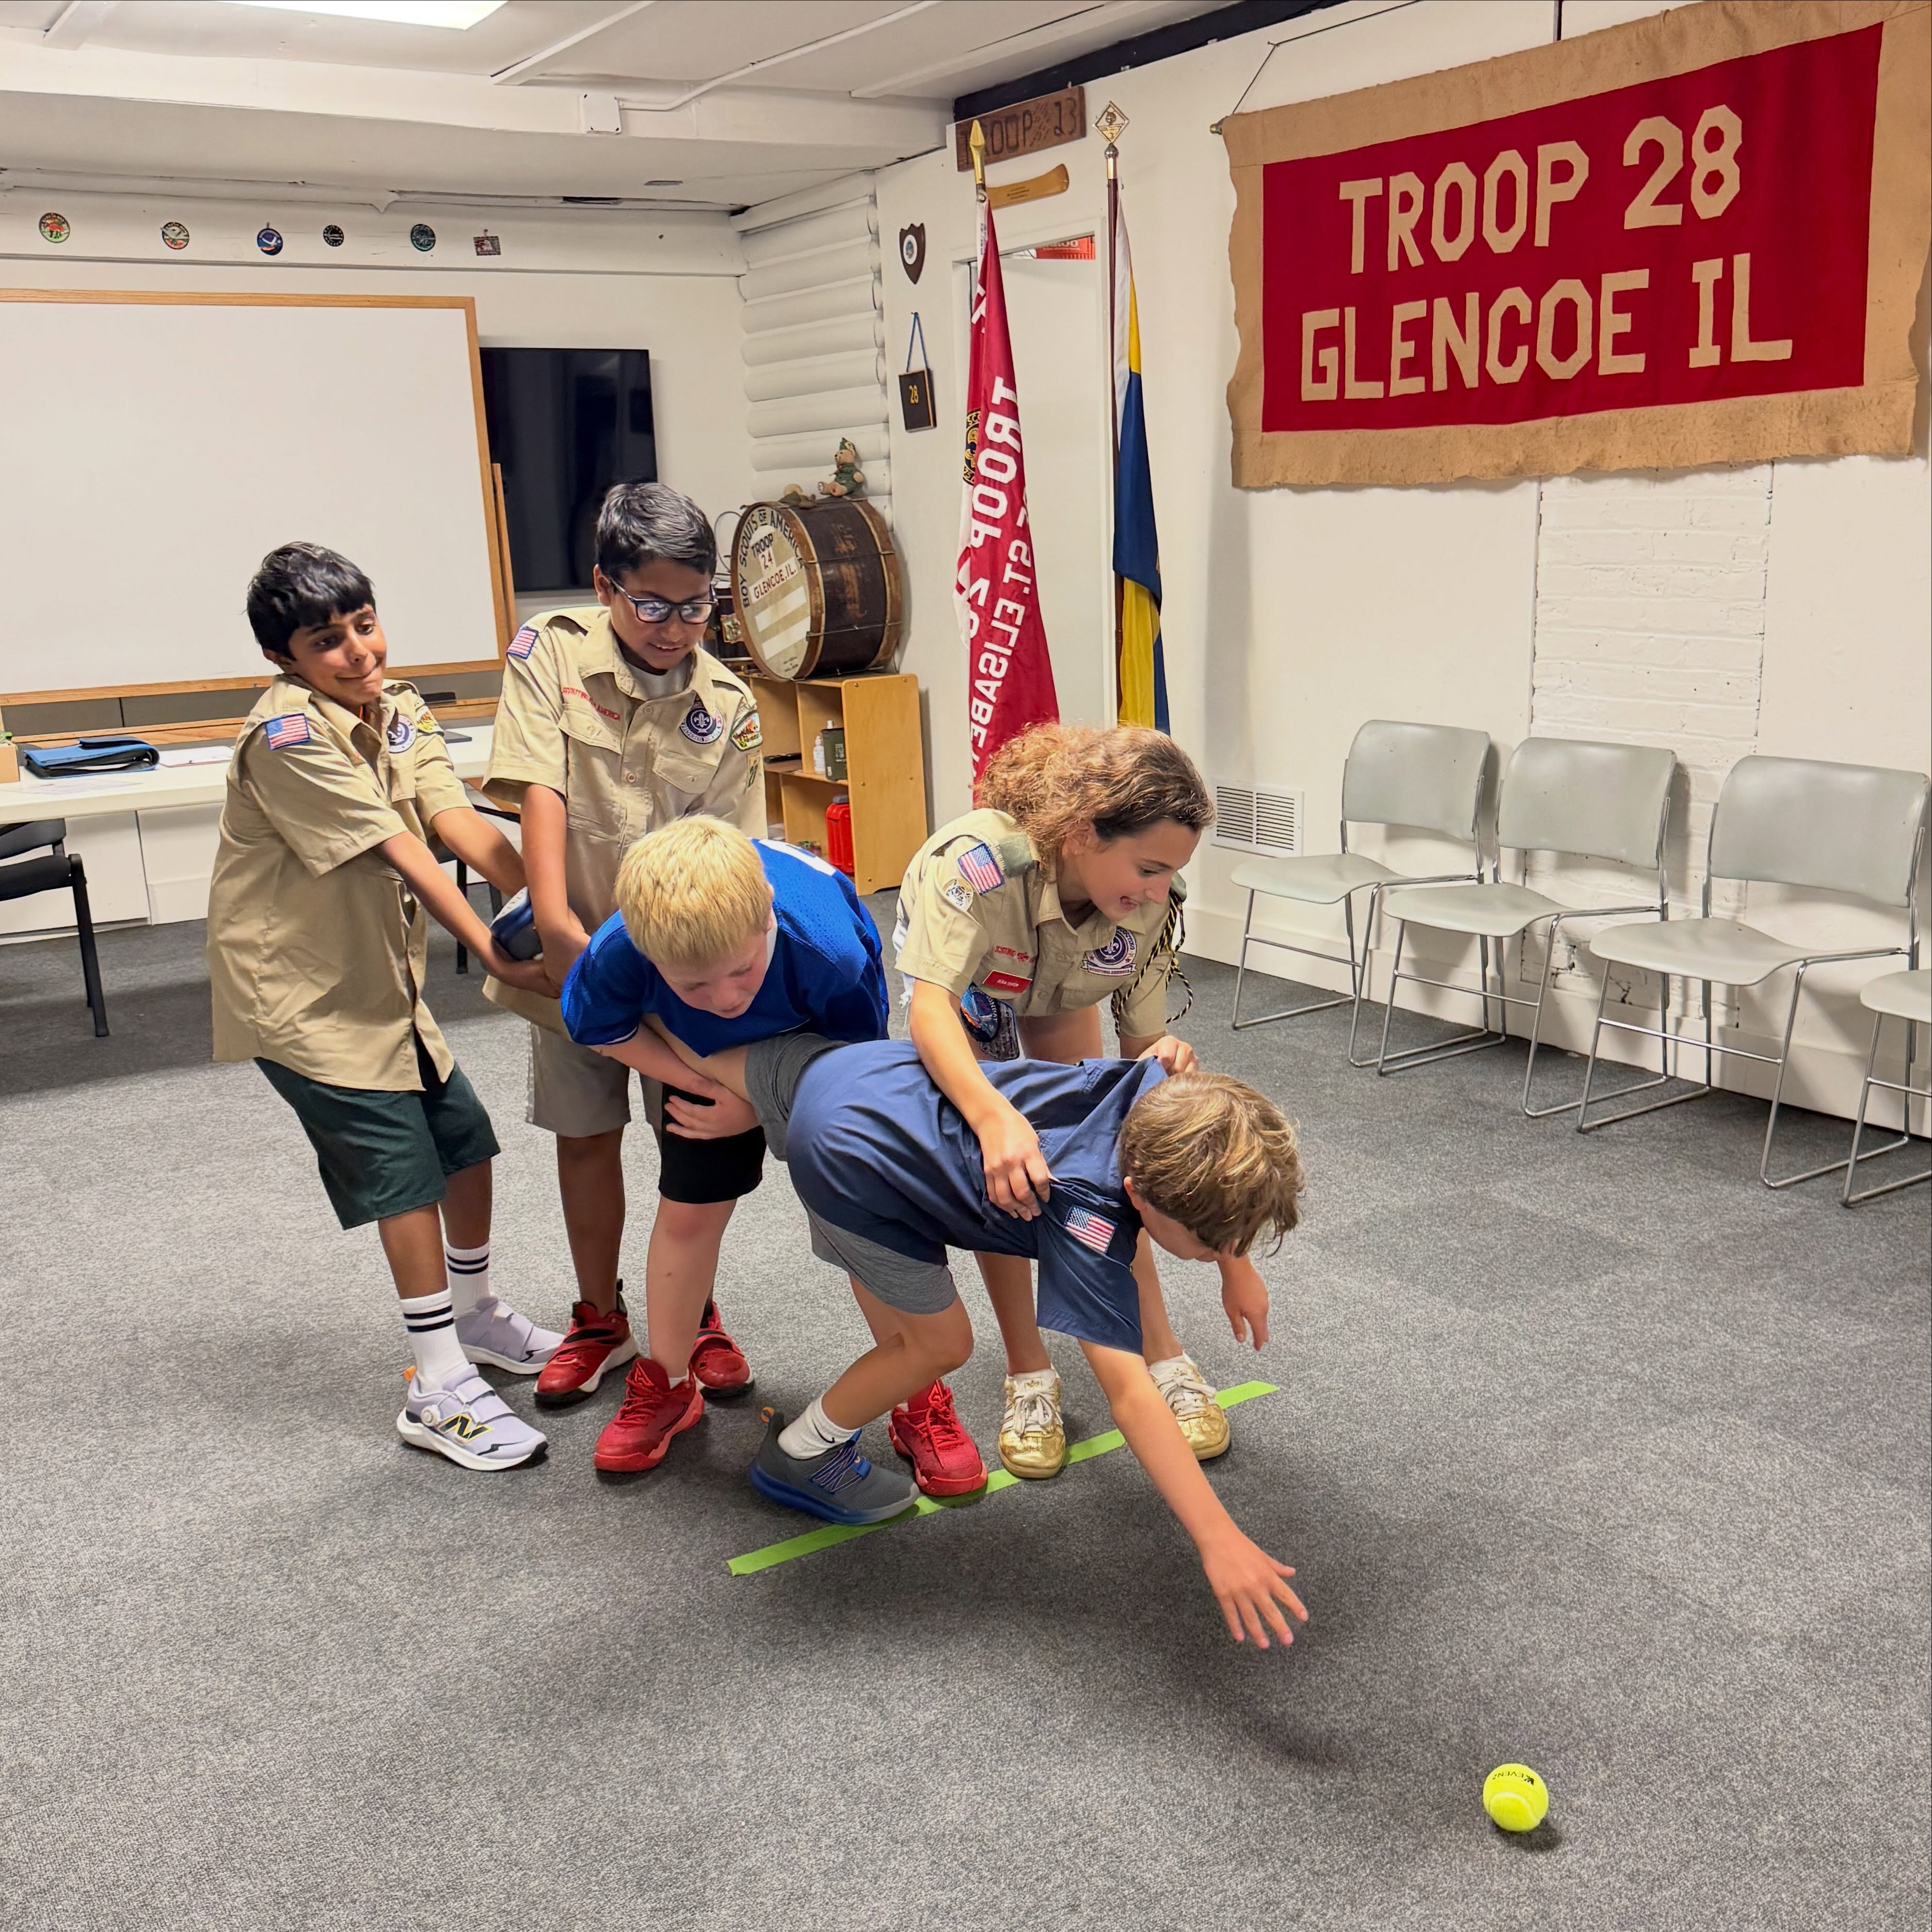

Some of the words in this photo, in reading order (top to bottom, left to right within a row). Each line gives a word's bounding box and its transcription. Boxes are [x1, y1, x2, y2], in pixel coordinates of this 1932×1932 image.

[1339, 140, 1590, 274] TROOP
[1623, 104, 1742, 230] 28
[1301, 268, 1649, 402] GLENCOE
[1688, 252, 1793, 369] IL
[909, 385, 918, 404] 28
[758, 510, 767, 524] OF
[740, 514, 758, 567] SCOUTS
[752, 533, 773, 557] TROOP
[761, 550, 773, 569] 24
[739, 573, 750, 608] BOY
